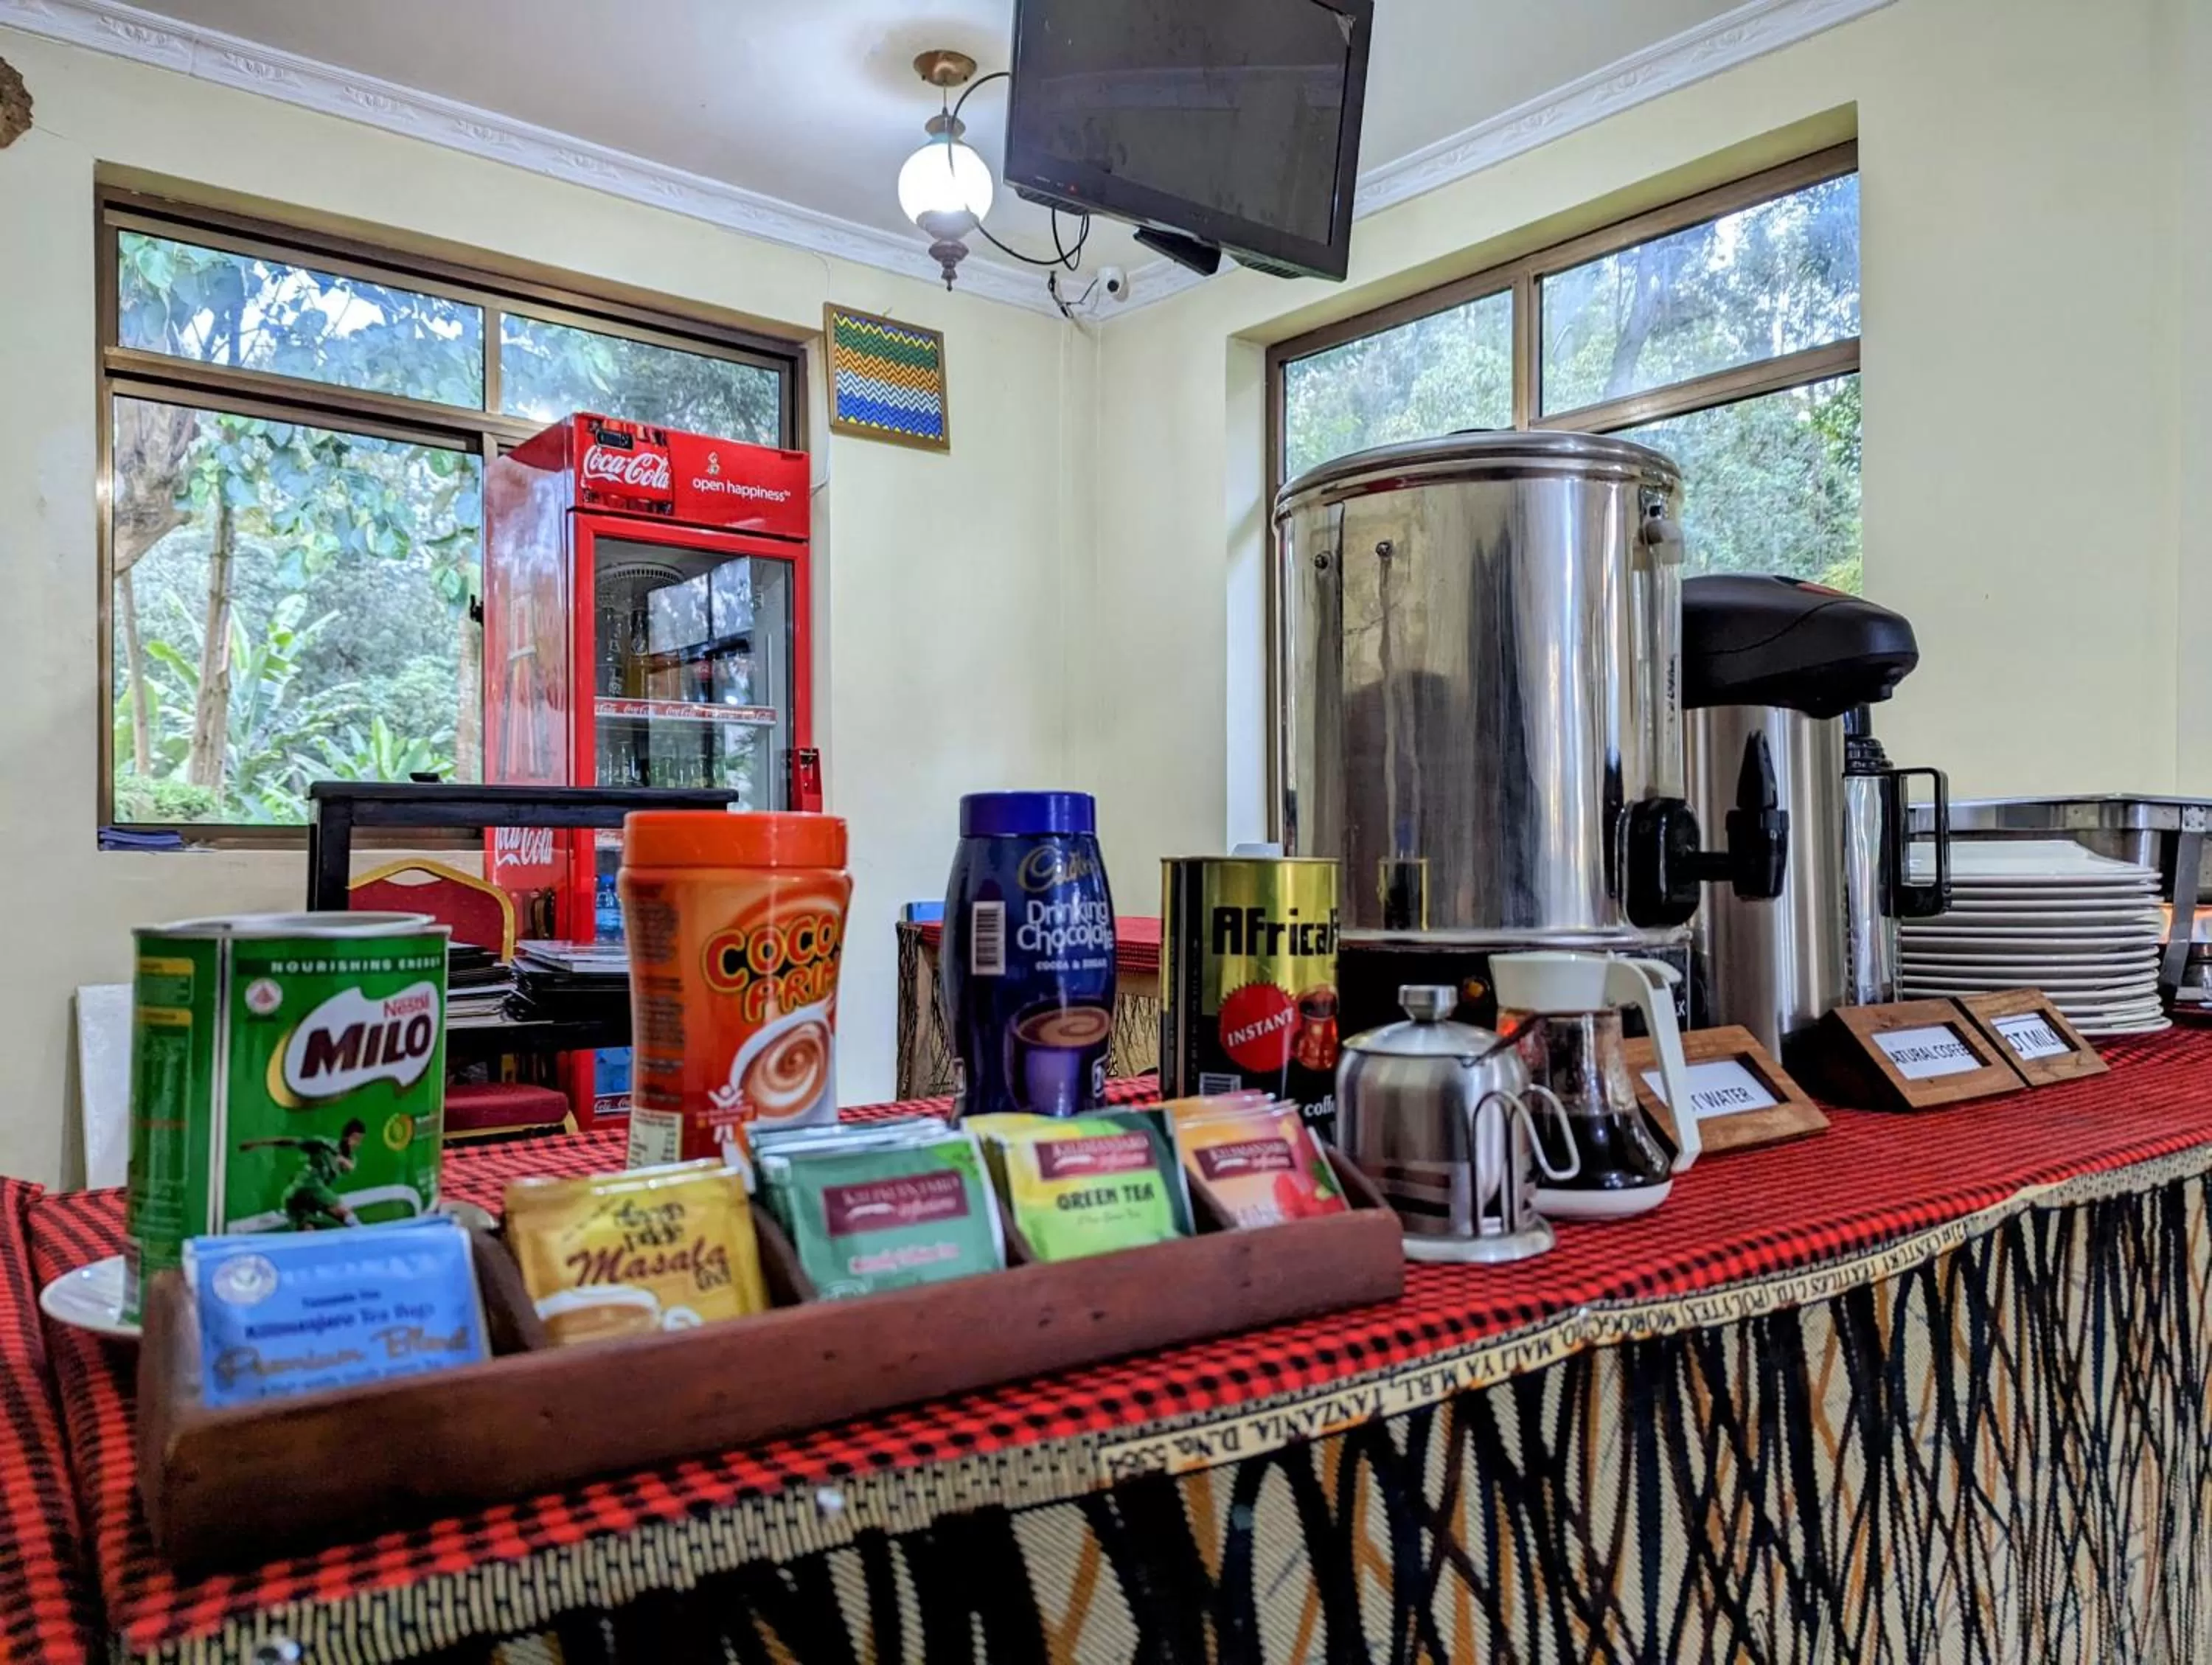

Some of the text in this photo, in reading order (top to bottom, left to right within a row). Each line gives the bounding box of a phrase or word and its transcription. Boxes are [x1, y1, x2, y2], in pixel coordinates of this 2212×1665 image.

[582, 444, 671, 490] Coca-Cola
[692, 478, 724, 493] open
[1027, 900, 1109, 927] Drinking
[701, 914, 841, 993] COCO
[1017, 922, 1115, 956] Chocolate
[271, 959, 392, 973] NOURISHING
[1227, 1007, 1295, 1048] INSTANT
[300, 1014, 433, 1080] MILO
[1698, 1086, 1758, 1108] WATER
[1056, 1181, 1155, 1210] GREEN TEA
[567, 1236, 727, 1287] Masala
[1466, 1355, 1495, 1380] YA
[1501, 1335, 1553, 1372] MALI
